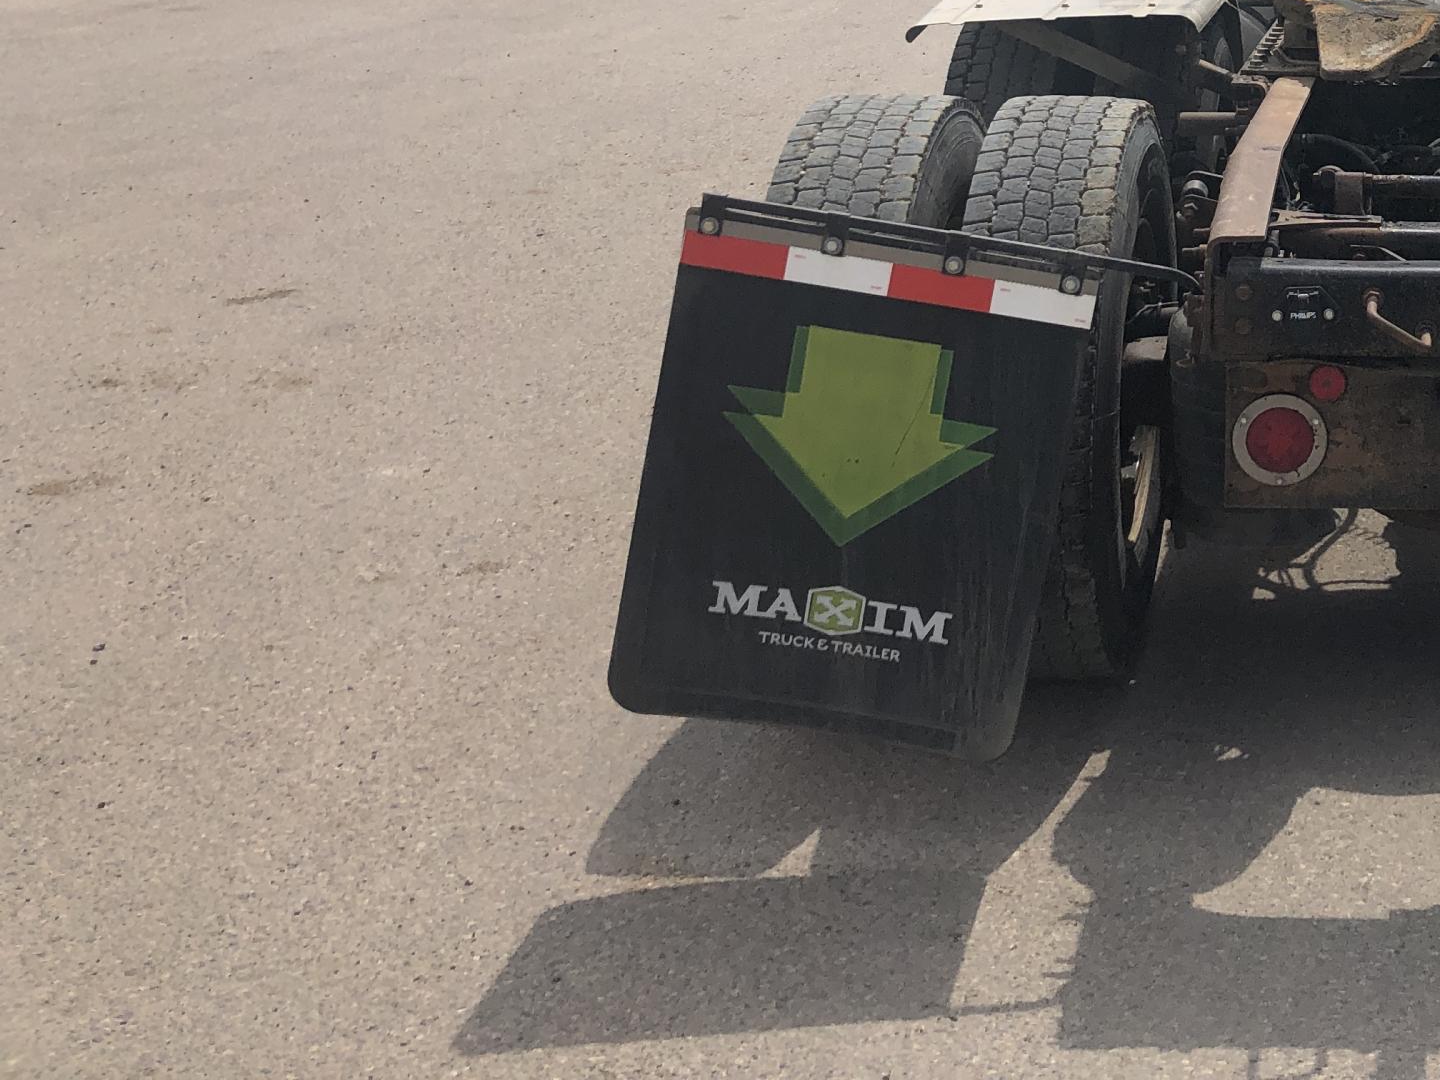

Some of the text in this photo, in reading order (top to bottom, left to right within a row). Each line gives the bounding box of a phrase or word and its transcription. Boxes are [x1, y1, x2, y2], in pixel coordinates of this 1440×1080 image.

[708, 580, 953, 646] MAXIM
[758, 631, 815, 650] TRUCK
[831, 640, 900, 663] TRAILER
